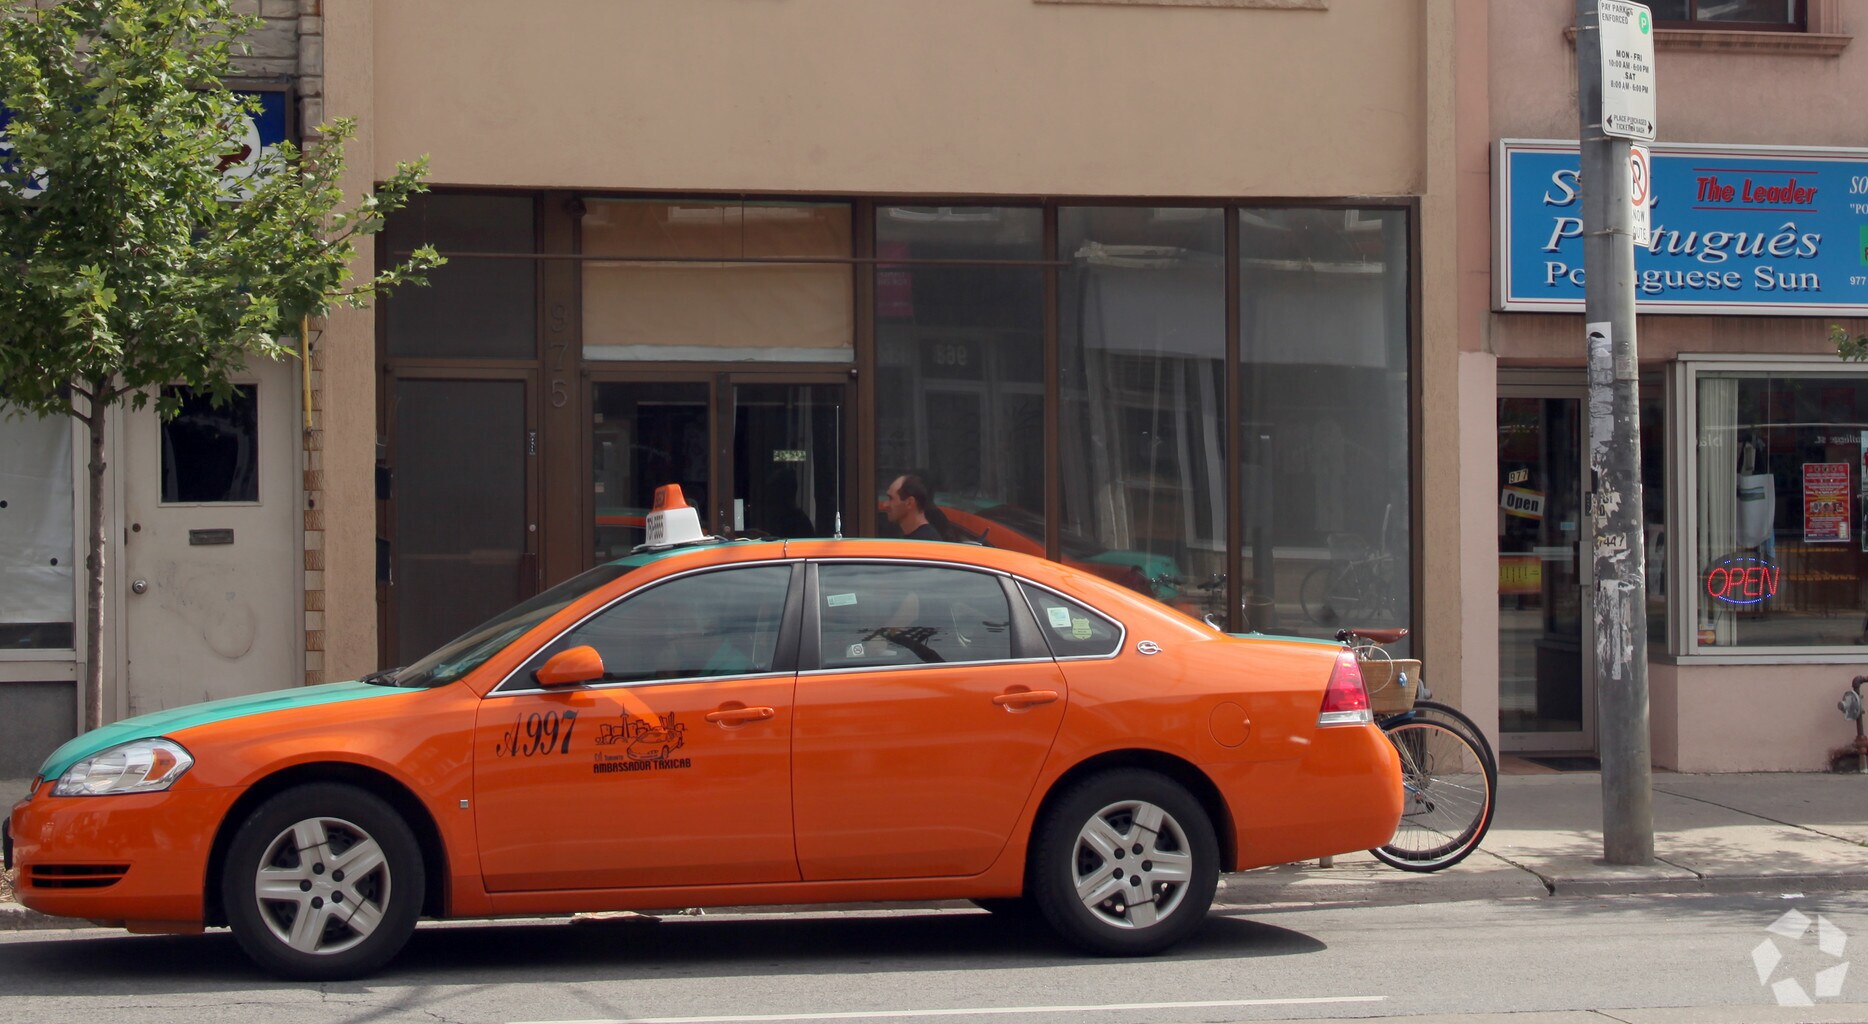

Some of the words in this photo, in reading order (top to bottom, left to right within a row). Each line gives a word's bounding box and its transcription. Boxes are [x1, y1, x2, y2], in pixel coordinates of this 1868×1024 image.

[1601, 2, 1611, 12] PAY
[1602, 13, 1628, 25] ENFORCED
[1616, 49, 1630, 59] MON
[1633, 53, 1643, 62] FRI
[1625, 71, 1636, 81] SAT
[1697, 177, 1735, 203] The
[1742, 179, 1818, 204] Leader
[1541, 216, 1823, 264] Ptuguês
[1754, 264, 1822, 292] Sun
[1849, 276, 1867, 286] 977
[1510, 469, 1527, 483] 977
[1506, 492, 1539, 513] Open
[1707, 567, 1780, 597] OPEN
[496, 709, 579, 759] A997
[593, 760, 651, 774] AMBASSADOR
[653, 757, 691, 770] TAXICAB
